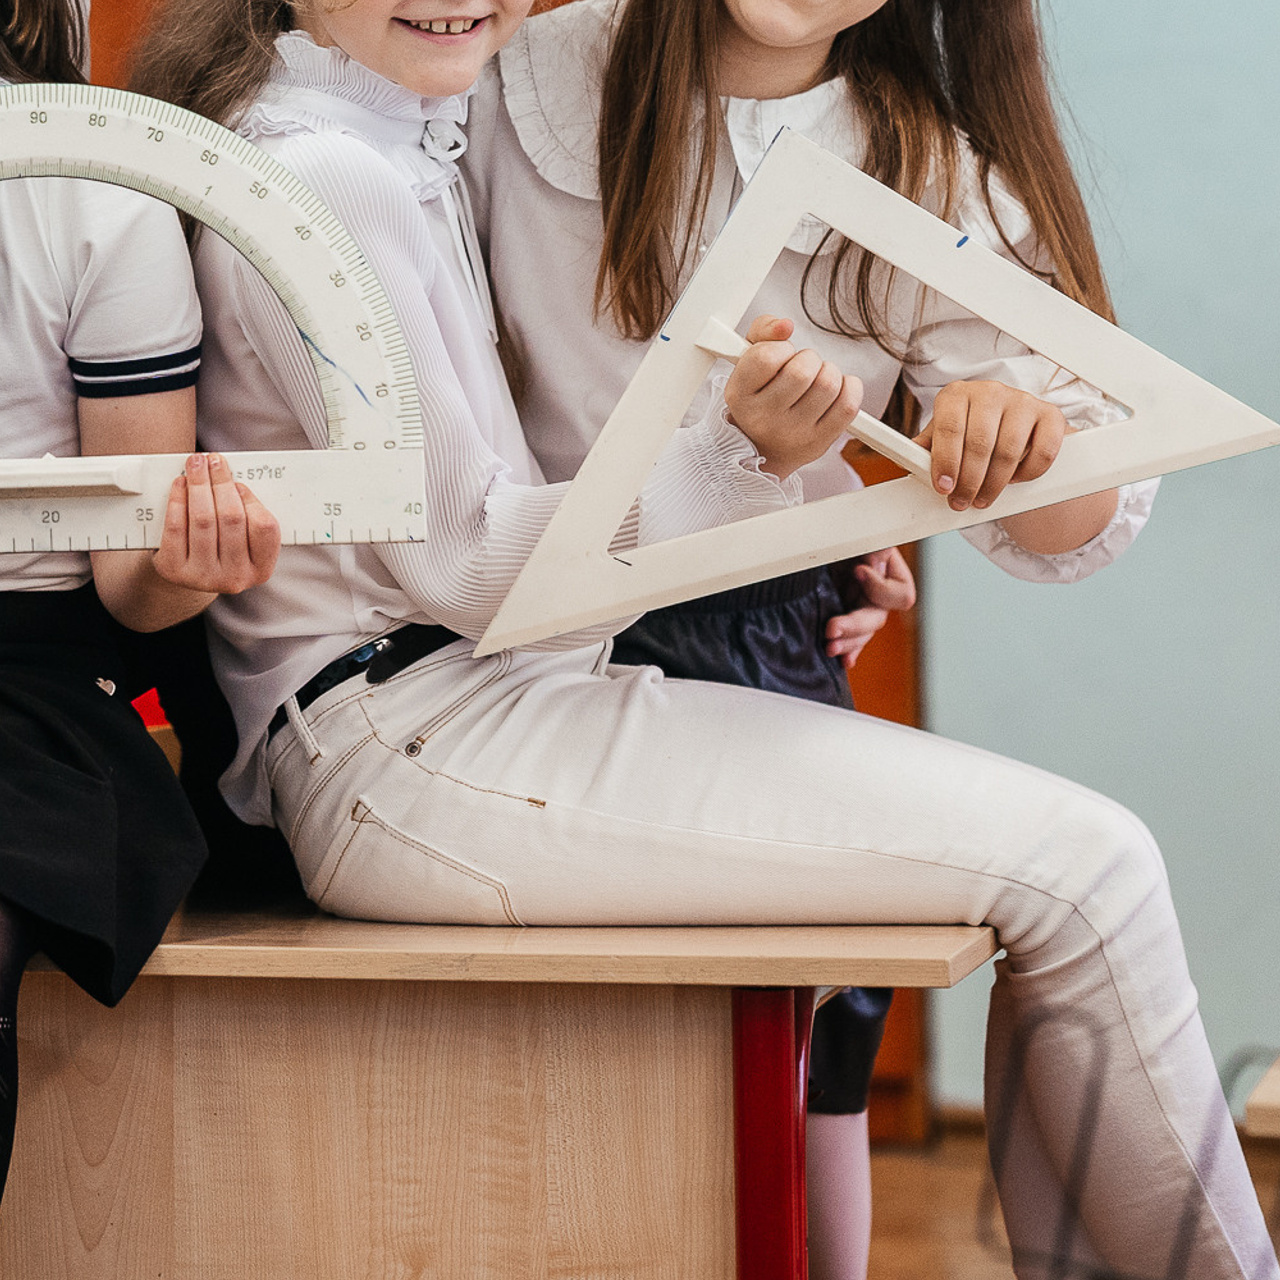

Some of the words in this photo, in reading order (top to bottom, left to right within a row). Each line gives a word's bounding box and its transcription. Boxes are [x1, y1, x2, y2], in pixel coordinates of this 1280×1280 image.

[30, 111, 48, 124] 90
[88, 113, 107, 128] 80
[147, 126, 164, 142] 70
[200, 149, 219, 166] 60
[249, 181, 269, 200] 50
[294, 224, 313, 241] 40
[328, 269, 347, 288] 30
[355, 322, 372, 342] 20
[375, 382, 389, 398] 10
[383, 440, 396, 450] 0
[204, 185, 213, 196] 1
[353, 441, 366, 451] 0
[41, 510, 60, 524] 20
[135, 508, 154, 521] 25
[323, 503, 342, 516] 35
[404, 502, 423, 515] 40
